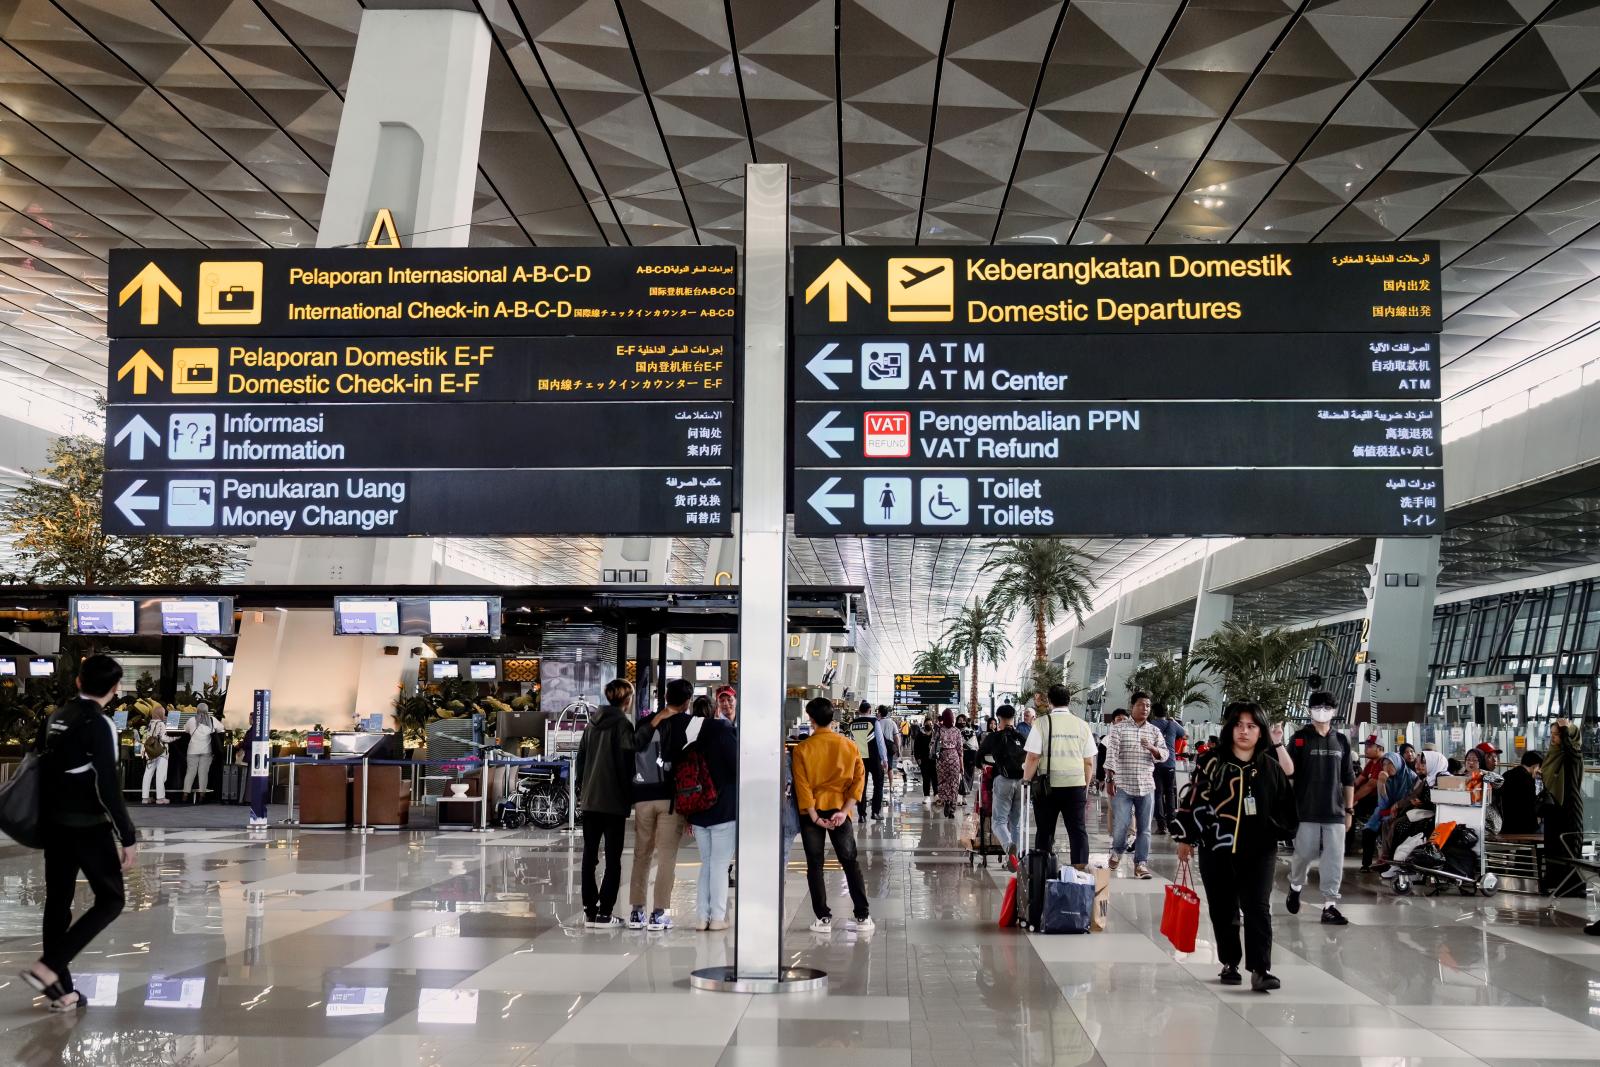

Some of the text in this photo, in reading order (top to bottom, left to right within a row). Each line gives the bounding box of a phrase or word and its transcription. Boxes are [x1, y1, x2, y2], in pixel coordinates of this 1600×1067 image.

[366, 208, 401, 248] A
[290, 266, 591, 288] Pelaporan Internasional A-B-C-D
[967, 254, 1292, 285] Keberangkatan Domestik
[1384, 280, 1430, 291] 国内出发
[289, 301, 572, 319] International Check-in A-B-C-D
[700, 309, 734, 317] A-B-C-D
[968, 299, 1241, 325] Domestic Departures
[1373, 306, 1431, 317] 国内線出発
[230, 346, 494, 371] Pelaporan Domestik E-F
[617, 346, 635, 355] E-F
[1372, 360, 1430, 371] 自动取款机
[229, 373, 480, 393] Domestic Check-in E-F
[704, 379, 722, 388] E-F
[992, 370, 1068, 390] Center
[1399, 379, 1431, 389] ATM
[224, 413, 323, 432] Informasi
[870, 418, 904, 432] VAT
[920, 410, 1139, 436] Pengembalian PPN
[688, 427, 722, 439] 问询处
[223, 440, 344, 460] Information
[687, 444, 721, 456] 案内所
[868, 440, 905, 448] REFUND
[920, 438, 1058, 458] VAT Refund
[222, 478, 405, 503] Penukaran Uang
[978, 478, 1041, 498] Toilet
[675, 495, 720, 506] 货币兑换
[1400, 496, 1436, 508] 洗手间
[222, 505, 398, 530] Money Changer
[686, 512, 720, 524] 両替店
[978, 505, 1054, 525] Toilets
[1403, 515, 1436, 526] トイレ
[790, 635, 800, 647] D
